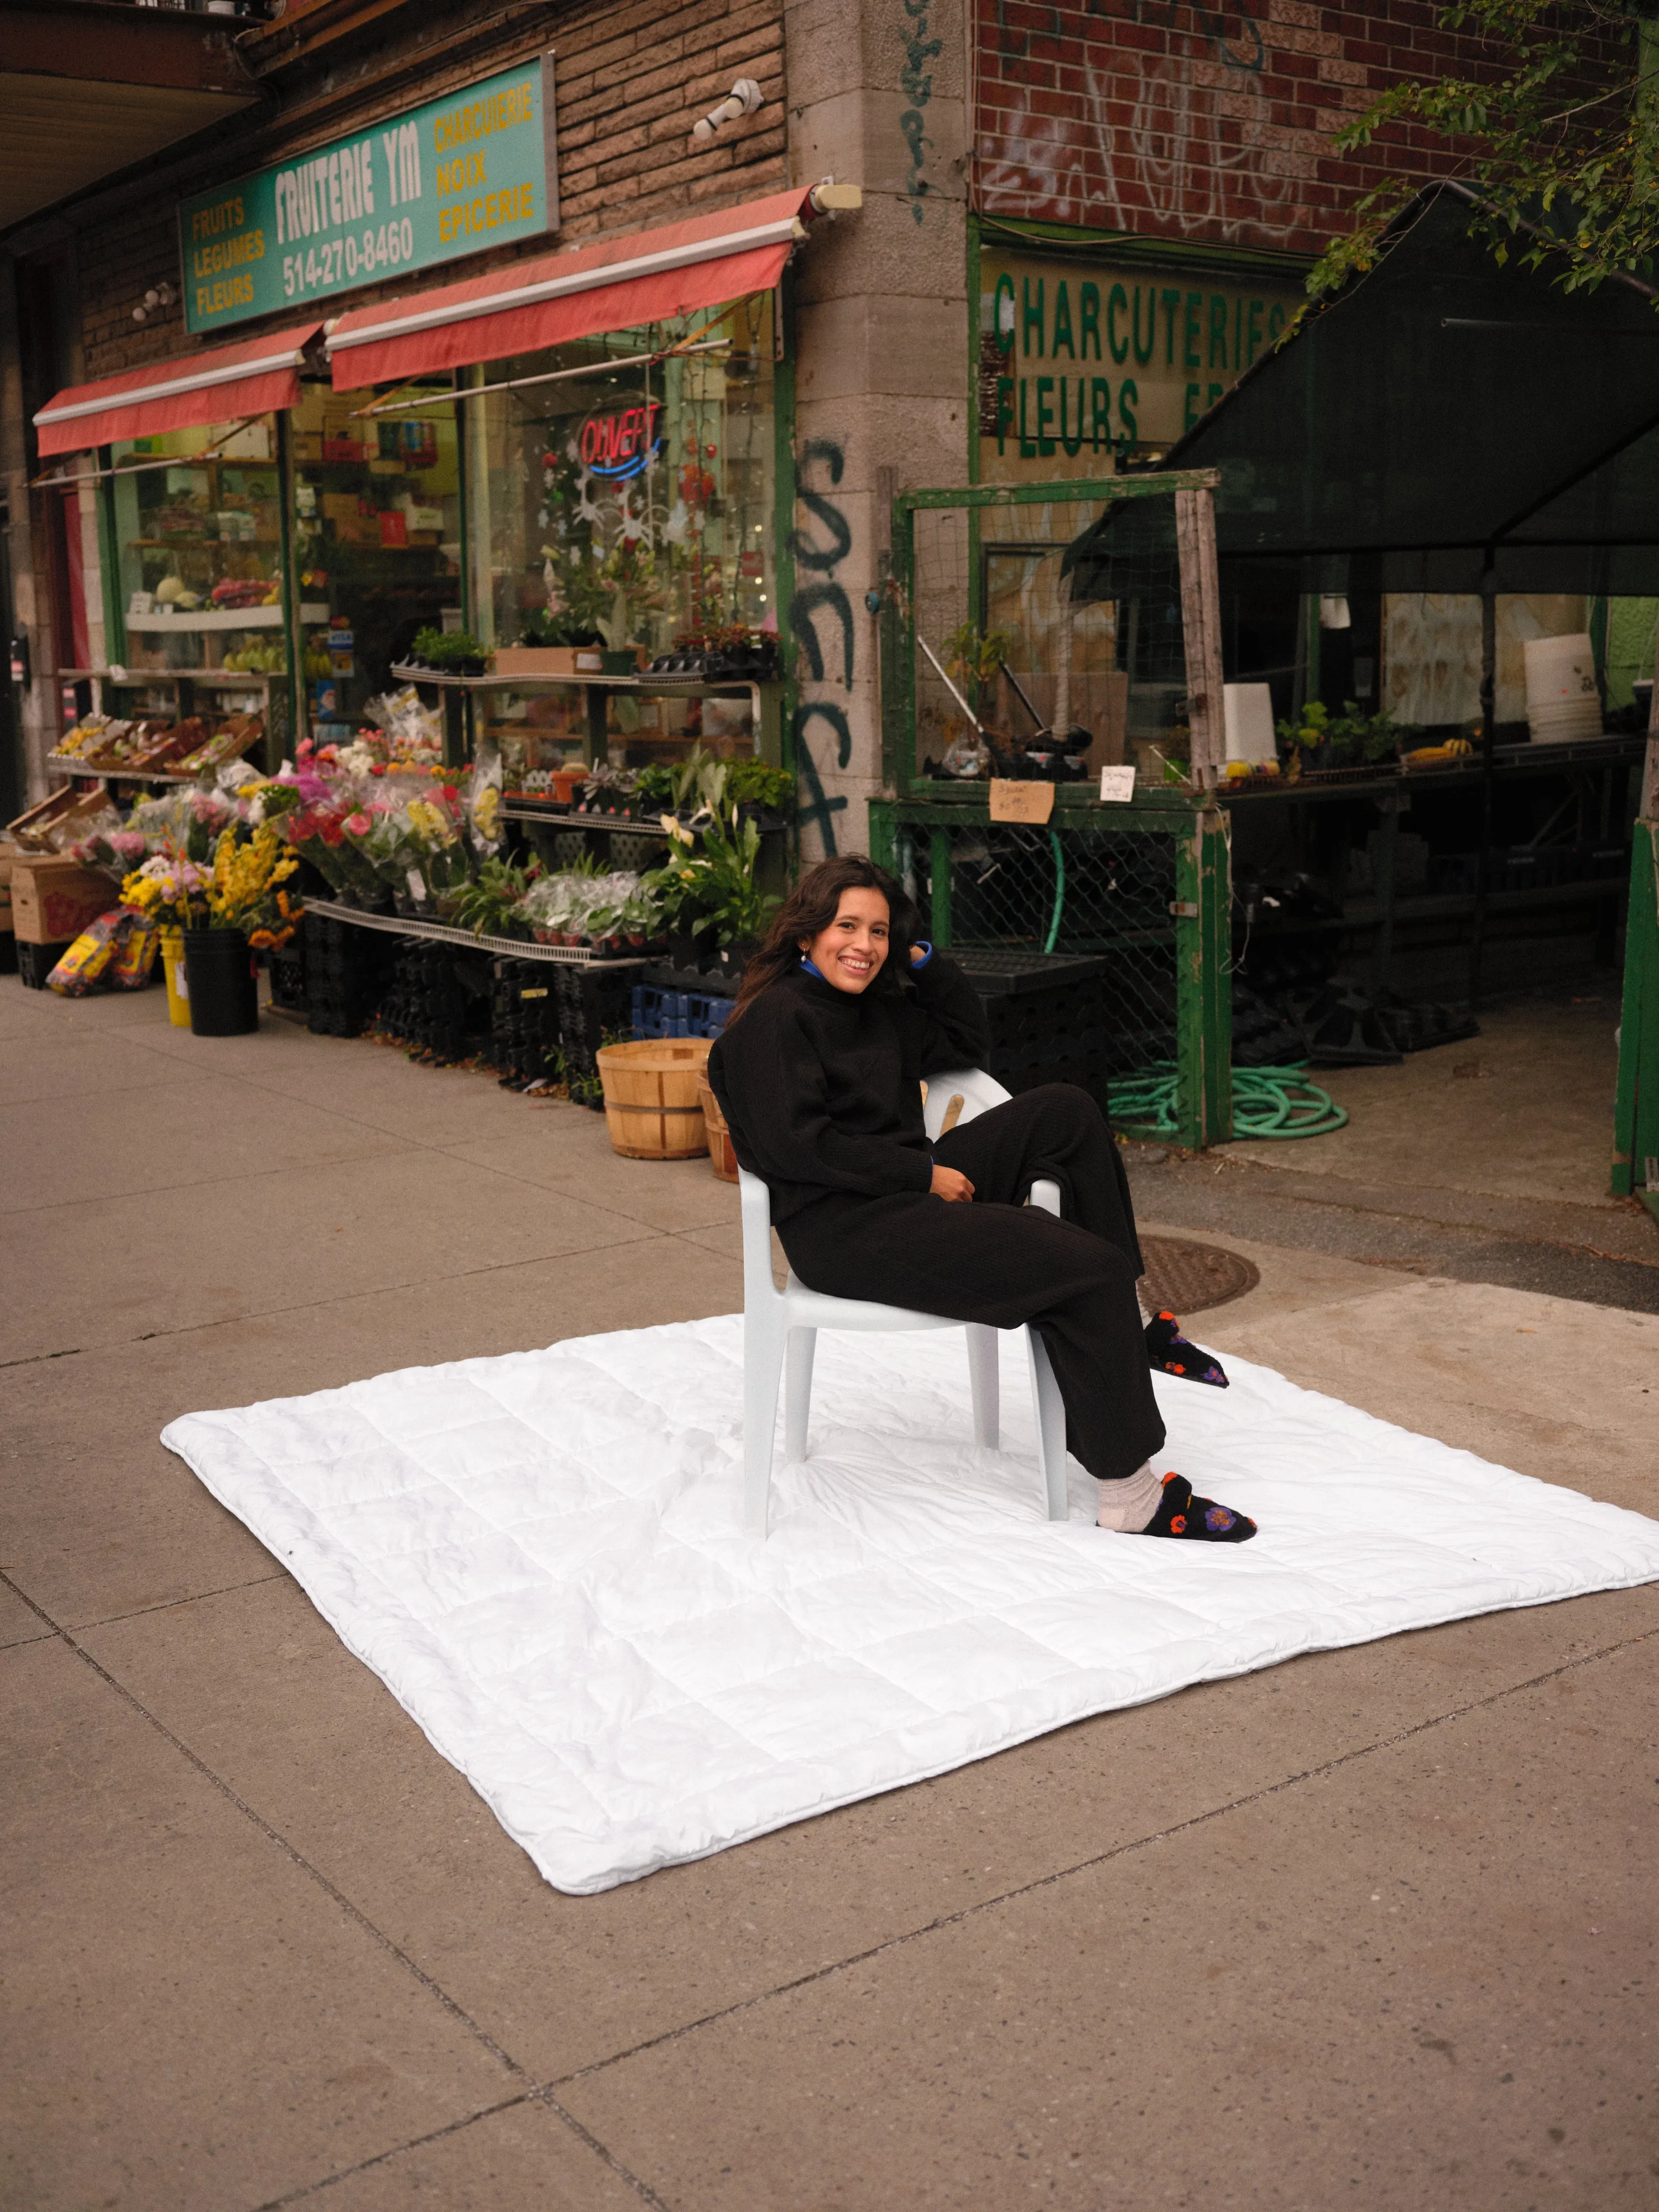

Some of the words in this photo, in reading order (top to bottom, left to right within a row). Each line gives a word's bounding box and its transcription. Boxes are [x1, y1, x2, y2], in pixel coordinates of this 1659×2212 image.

[275, 139, 374, 244] FRUITERIE
[383, 120, 421, 207] YM
[436, 148, 487, 198] NOIX
[192, 196, 244, 242] FRUITS
[439, 182, 534, 243] EPICERIE
[195, 229, 265, 279] LEGUMES
[283, 217, 413, 296] 514-270-8460
[196, 273, 254, 316] FLEURS
[996, 376, 1138, 458] FLEURS
